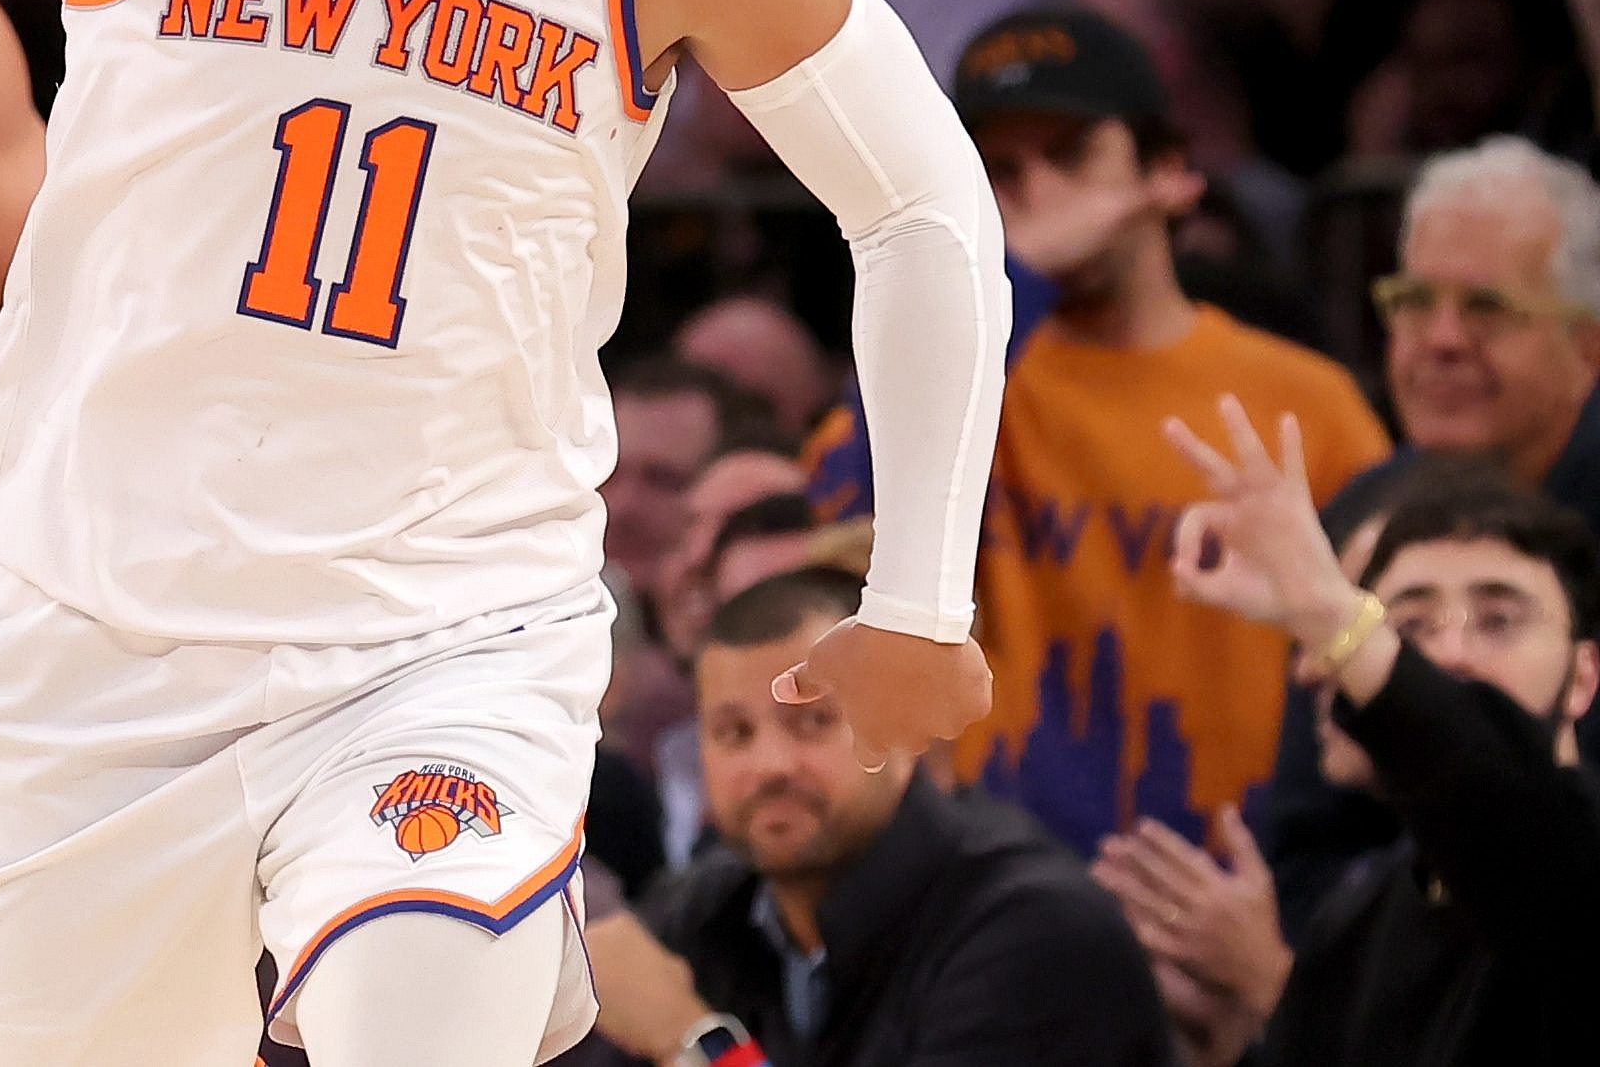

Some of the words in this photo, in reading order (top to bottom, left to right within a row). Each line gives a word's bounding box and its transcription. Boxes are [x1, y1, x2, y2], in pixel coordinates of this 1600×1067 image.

[236, 97, 437, 350] 11
[369, 770, 502, 838] KNICKS
[419, 763, 445, 774] NEW
[448, 764, 476, 783] YORK
